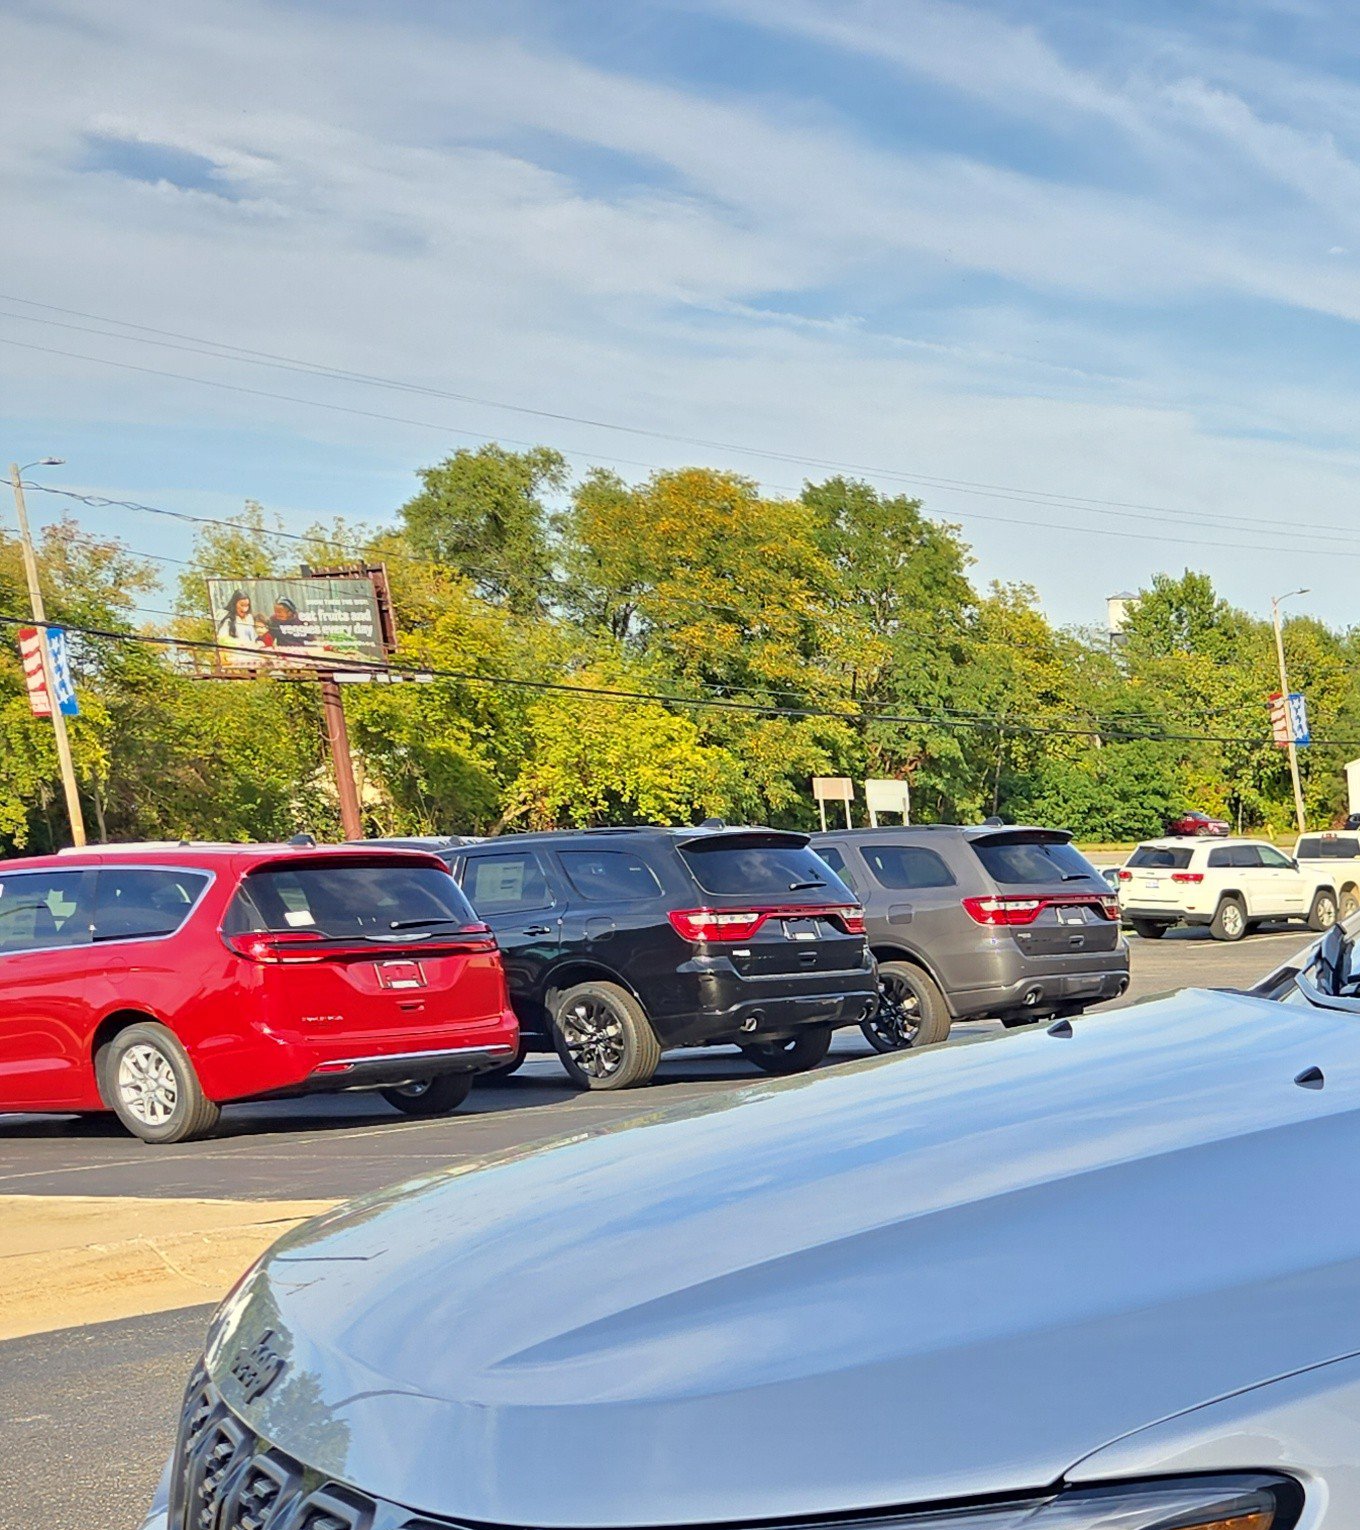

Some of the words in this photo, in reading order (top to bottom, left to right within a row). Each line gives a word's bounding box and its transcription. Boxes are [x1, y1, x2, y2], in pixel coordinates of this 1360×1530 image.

[298, 610, 318, 621] eat
[318, 609, 350, 621] fruits
[351, 609, 372, 622] and
[280, 622, 321, 637] veggies
[322, 625, 352, 637] every
[353, 622, 373, 637] day
